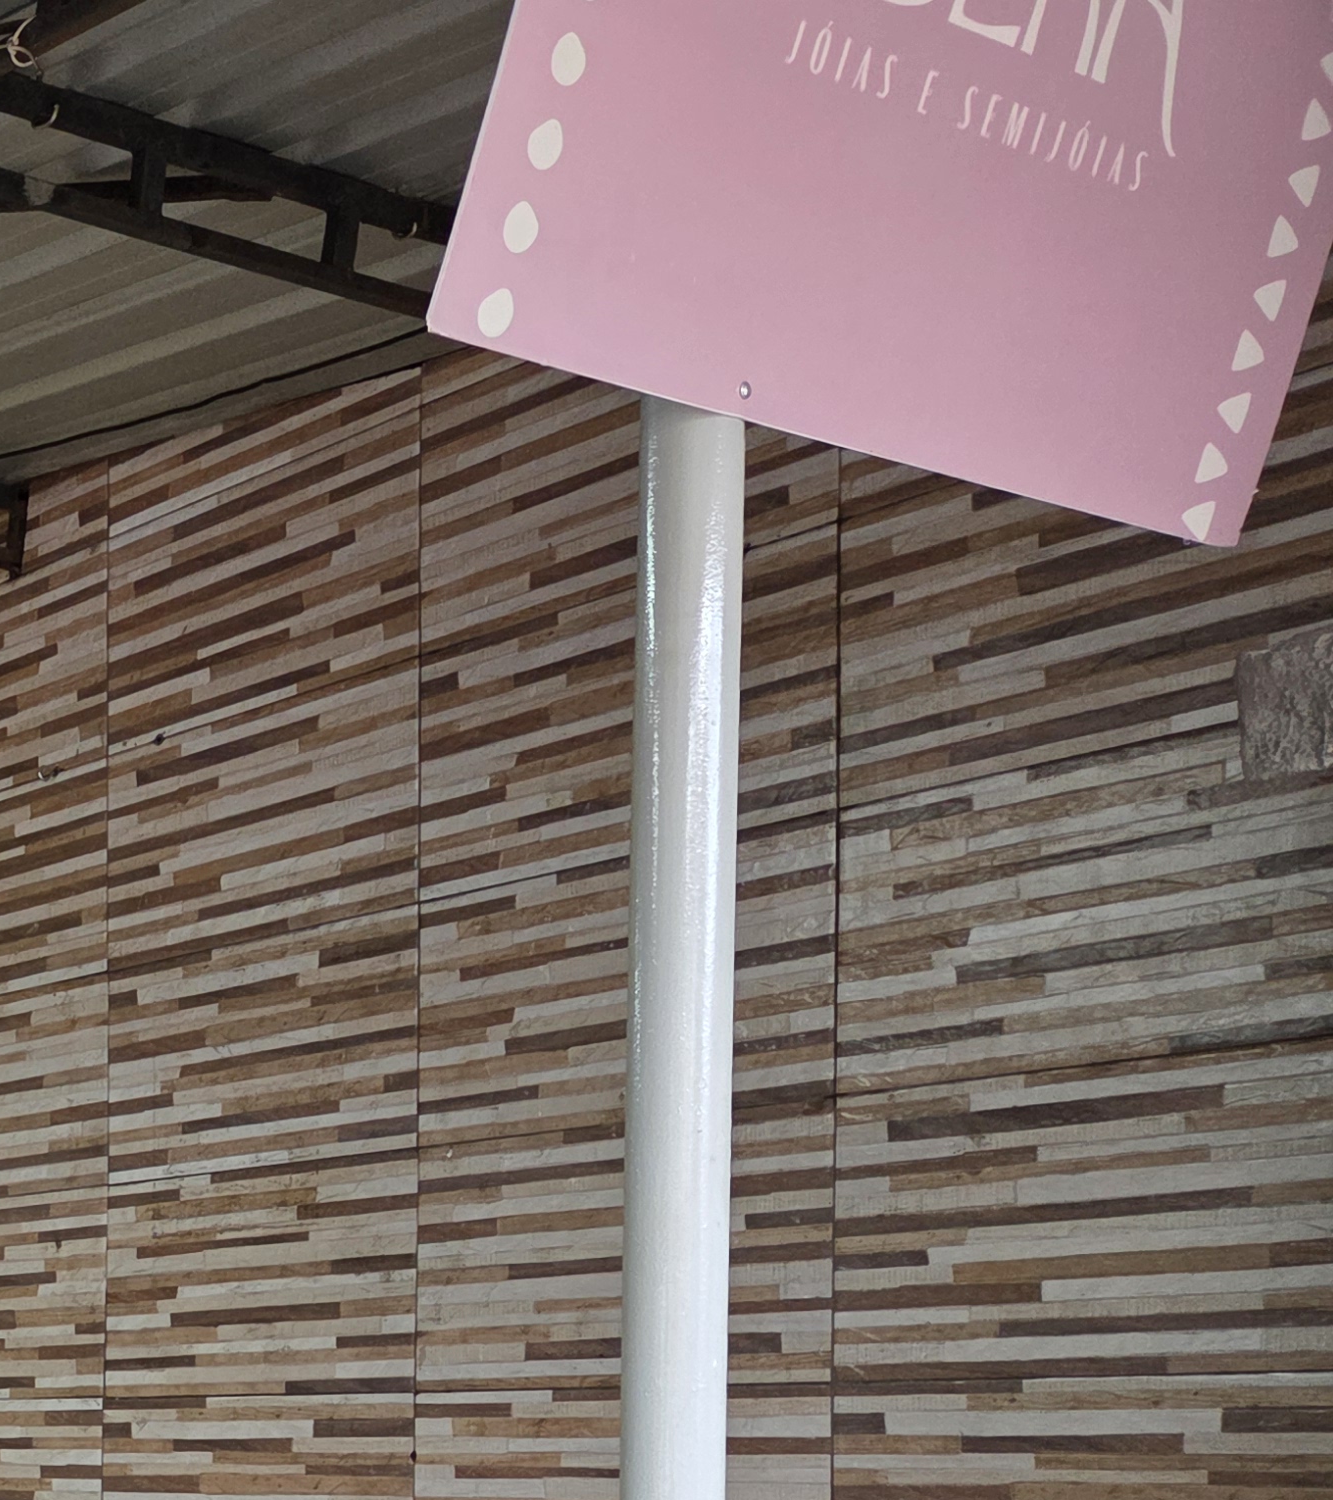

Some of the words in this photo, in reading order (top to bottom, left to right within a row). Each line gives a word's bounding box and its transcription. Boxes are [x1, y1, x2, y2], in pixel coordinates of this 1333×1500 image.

[785, 19, 899, 99] JÓIAS
[916, 69, 940, 115] E
[956, 85, 1149, 192] SEMIJÓIAS
